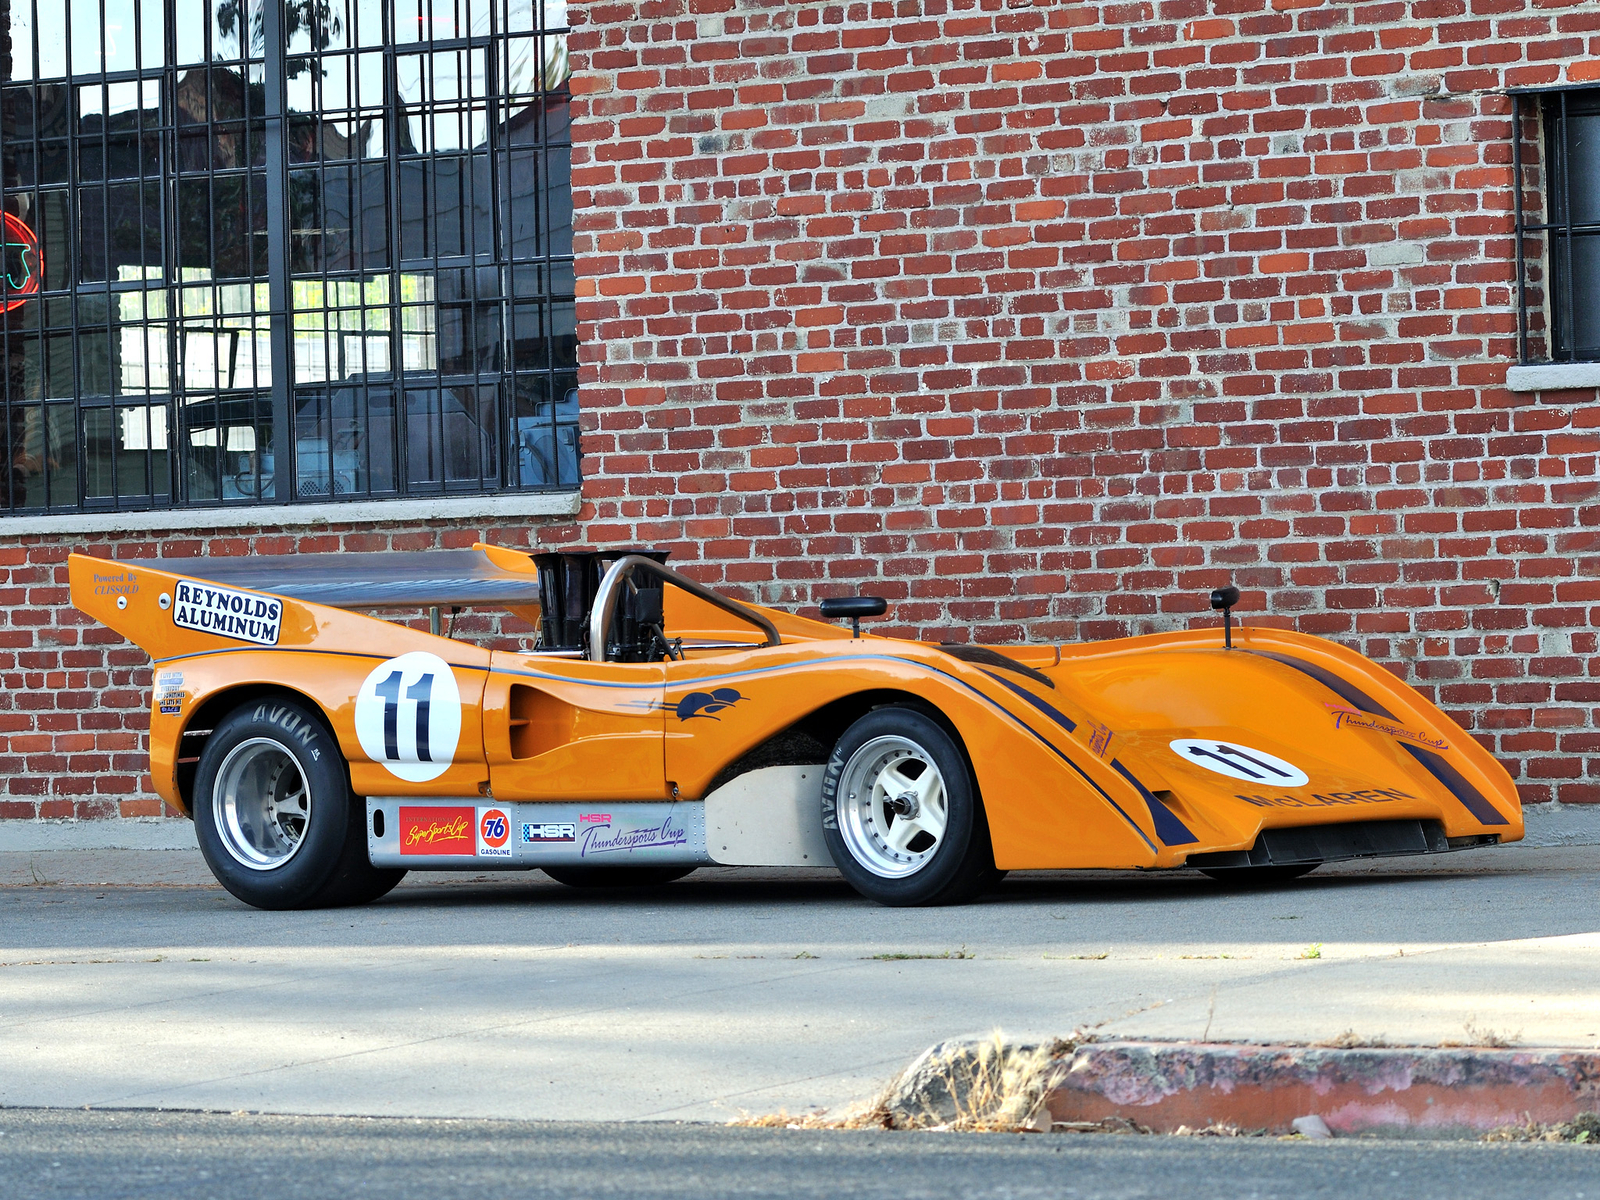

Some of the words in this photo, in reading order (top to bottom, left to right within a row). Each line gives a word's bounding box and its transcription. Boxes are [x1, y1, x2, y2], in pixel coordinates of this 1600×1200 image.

[93, 573, 124, 583] Powered
[127, 573, 137, 583] By
[94, 584, 139, 595] CLISSOLD
[178, 584, 279, 621] REYNOLDS
[176, 605, 277, 642] ALUMINUM
[251, 703, 318, 747] AVON
[374, 670, 435, 762] 11
[1331, 710, 1416, 738] Thundersports
[1418, 731, 1446, 748] Cup
[1187, 744, 1294, 779] 11
[822, 753, 845, 831] AVON
[1234, 787, 1420, 808] McLAREN
[484, 816, 506, 839] 76
[529, 824, 575, 838] HSR
[579, 813, 612, 823] HSR
[480, 848, 511, 856] GASOLINE
[580, 824, 658, 858] Thundersports
[659, 816, 686, 848] Cup
